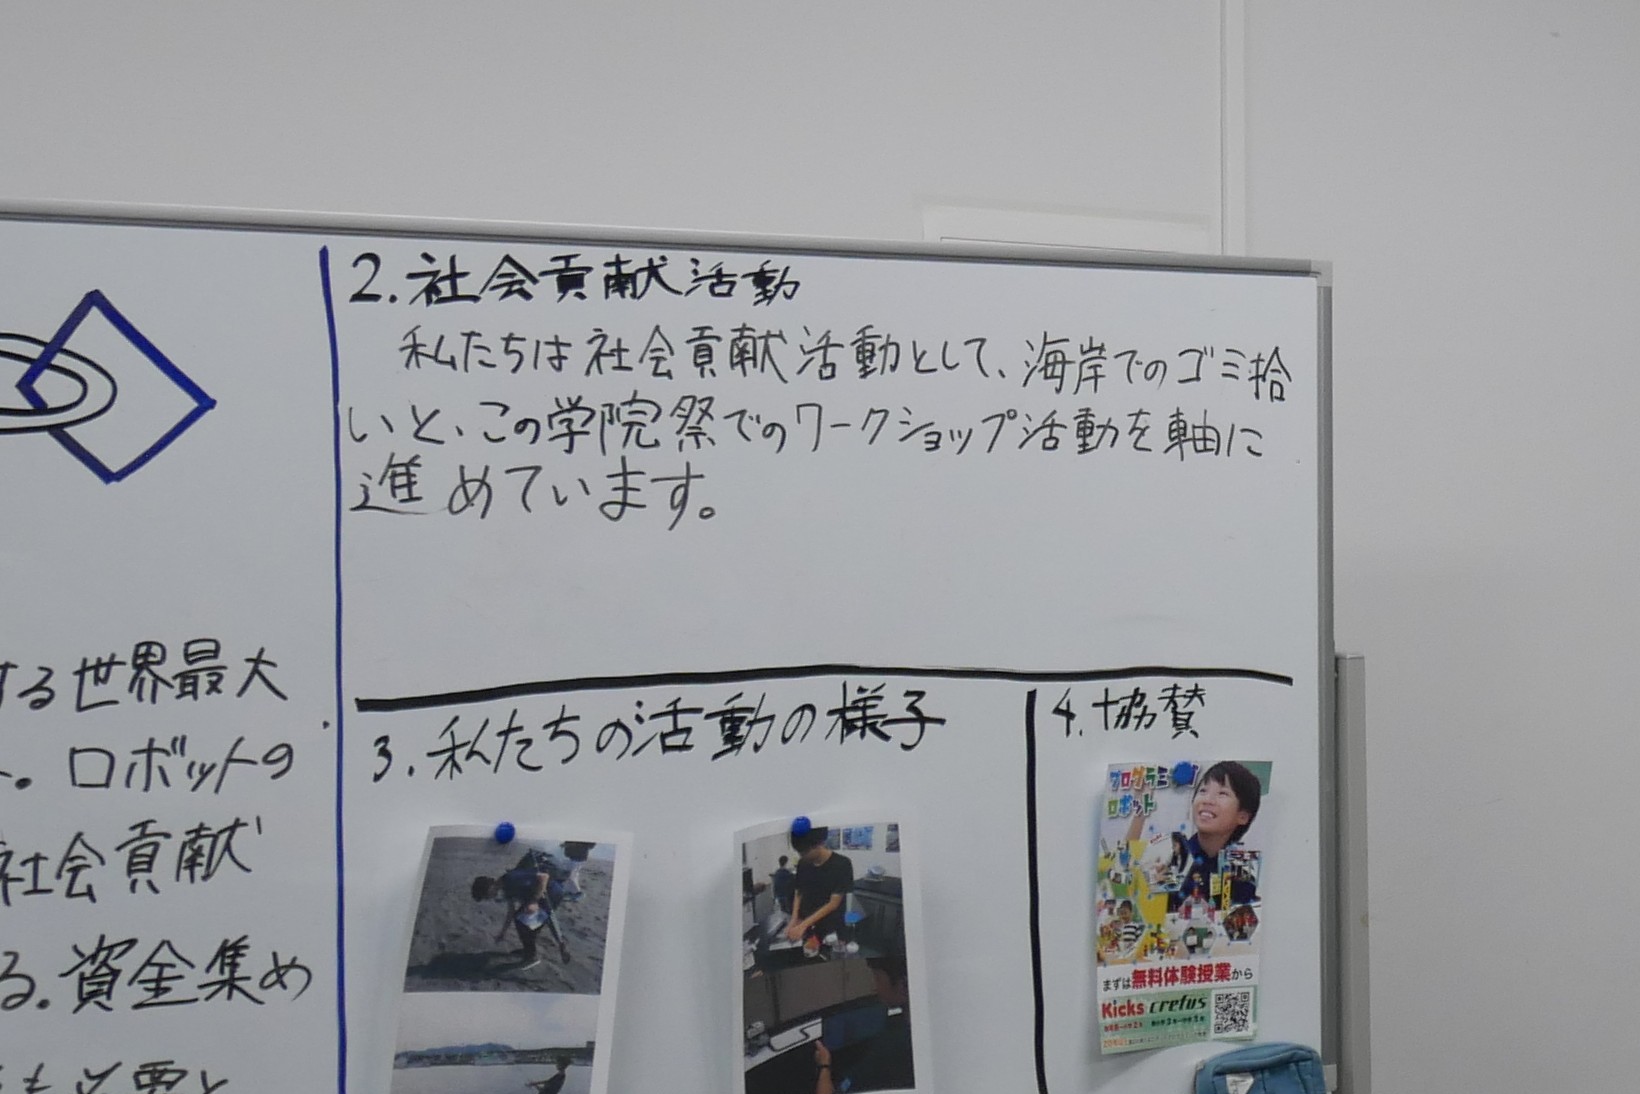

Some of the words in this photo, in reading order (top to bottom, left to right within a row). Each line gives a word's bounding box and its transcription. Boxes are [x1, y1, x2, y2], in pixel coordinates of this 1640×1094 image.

[349, 252, 801, 307] 2.社会貢献活動
[399, 323, 1293, 403] 私たちは社会貢献活動として、海岸でのゴミ拾
[349, 452, 716, 531] 進めています。
[373, 681, 947, 783] 3.私たちの活動の様子
[1052, 683, 1206, 739] 4.協賛
[1108, 793, 1155, 817] ロボット
[1103, 962, 1253, 992] まずは無料体験授業から
[1102, 1000, 1144, 1019] Kicks
[1150, 994, 1207, 1014] crefus
